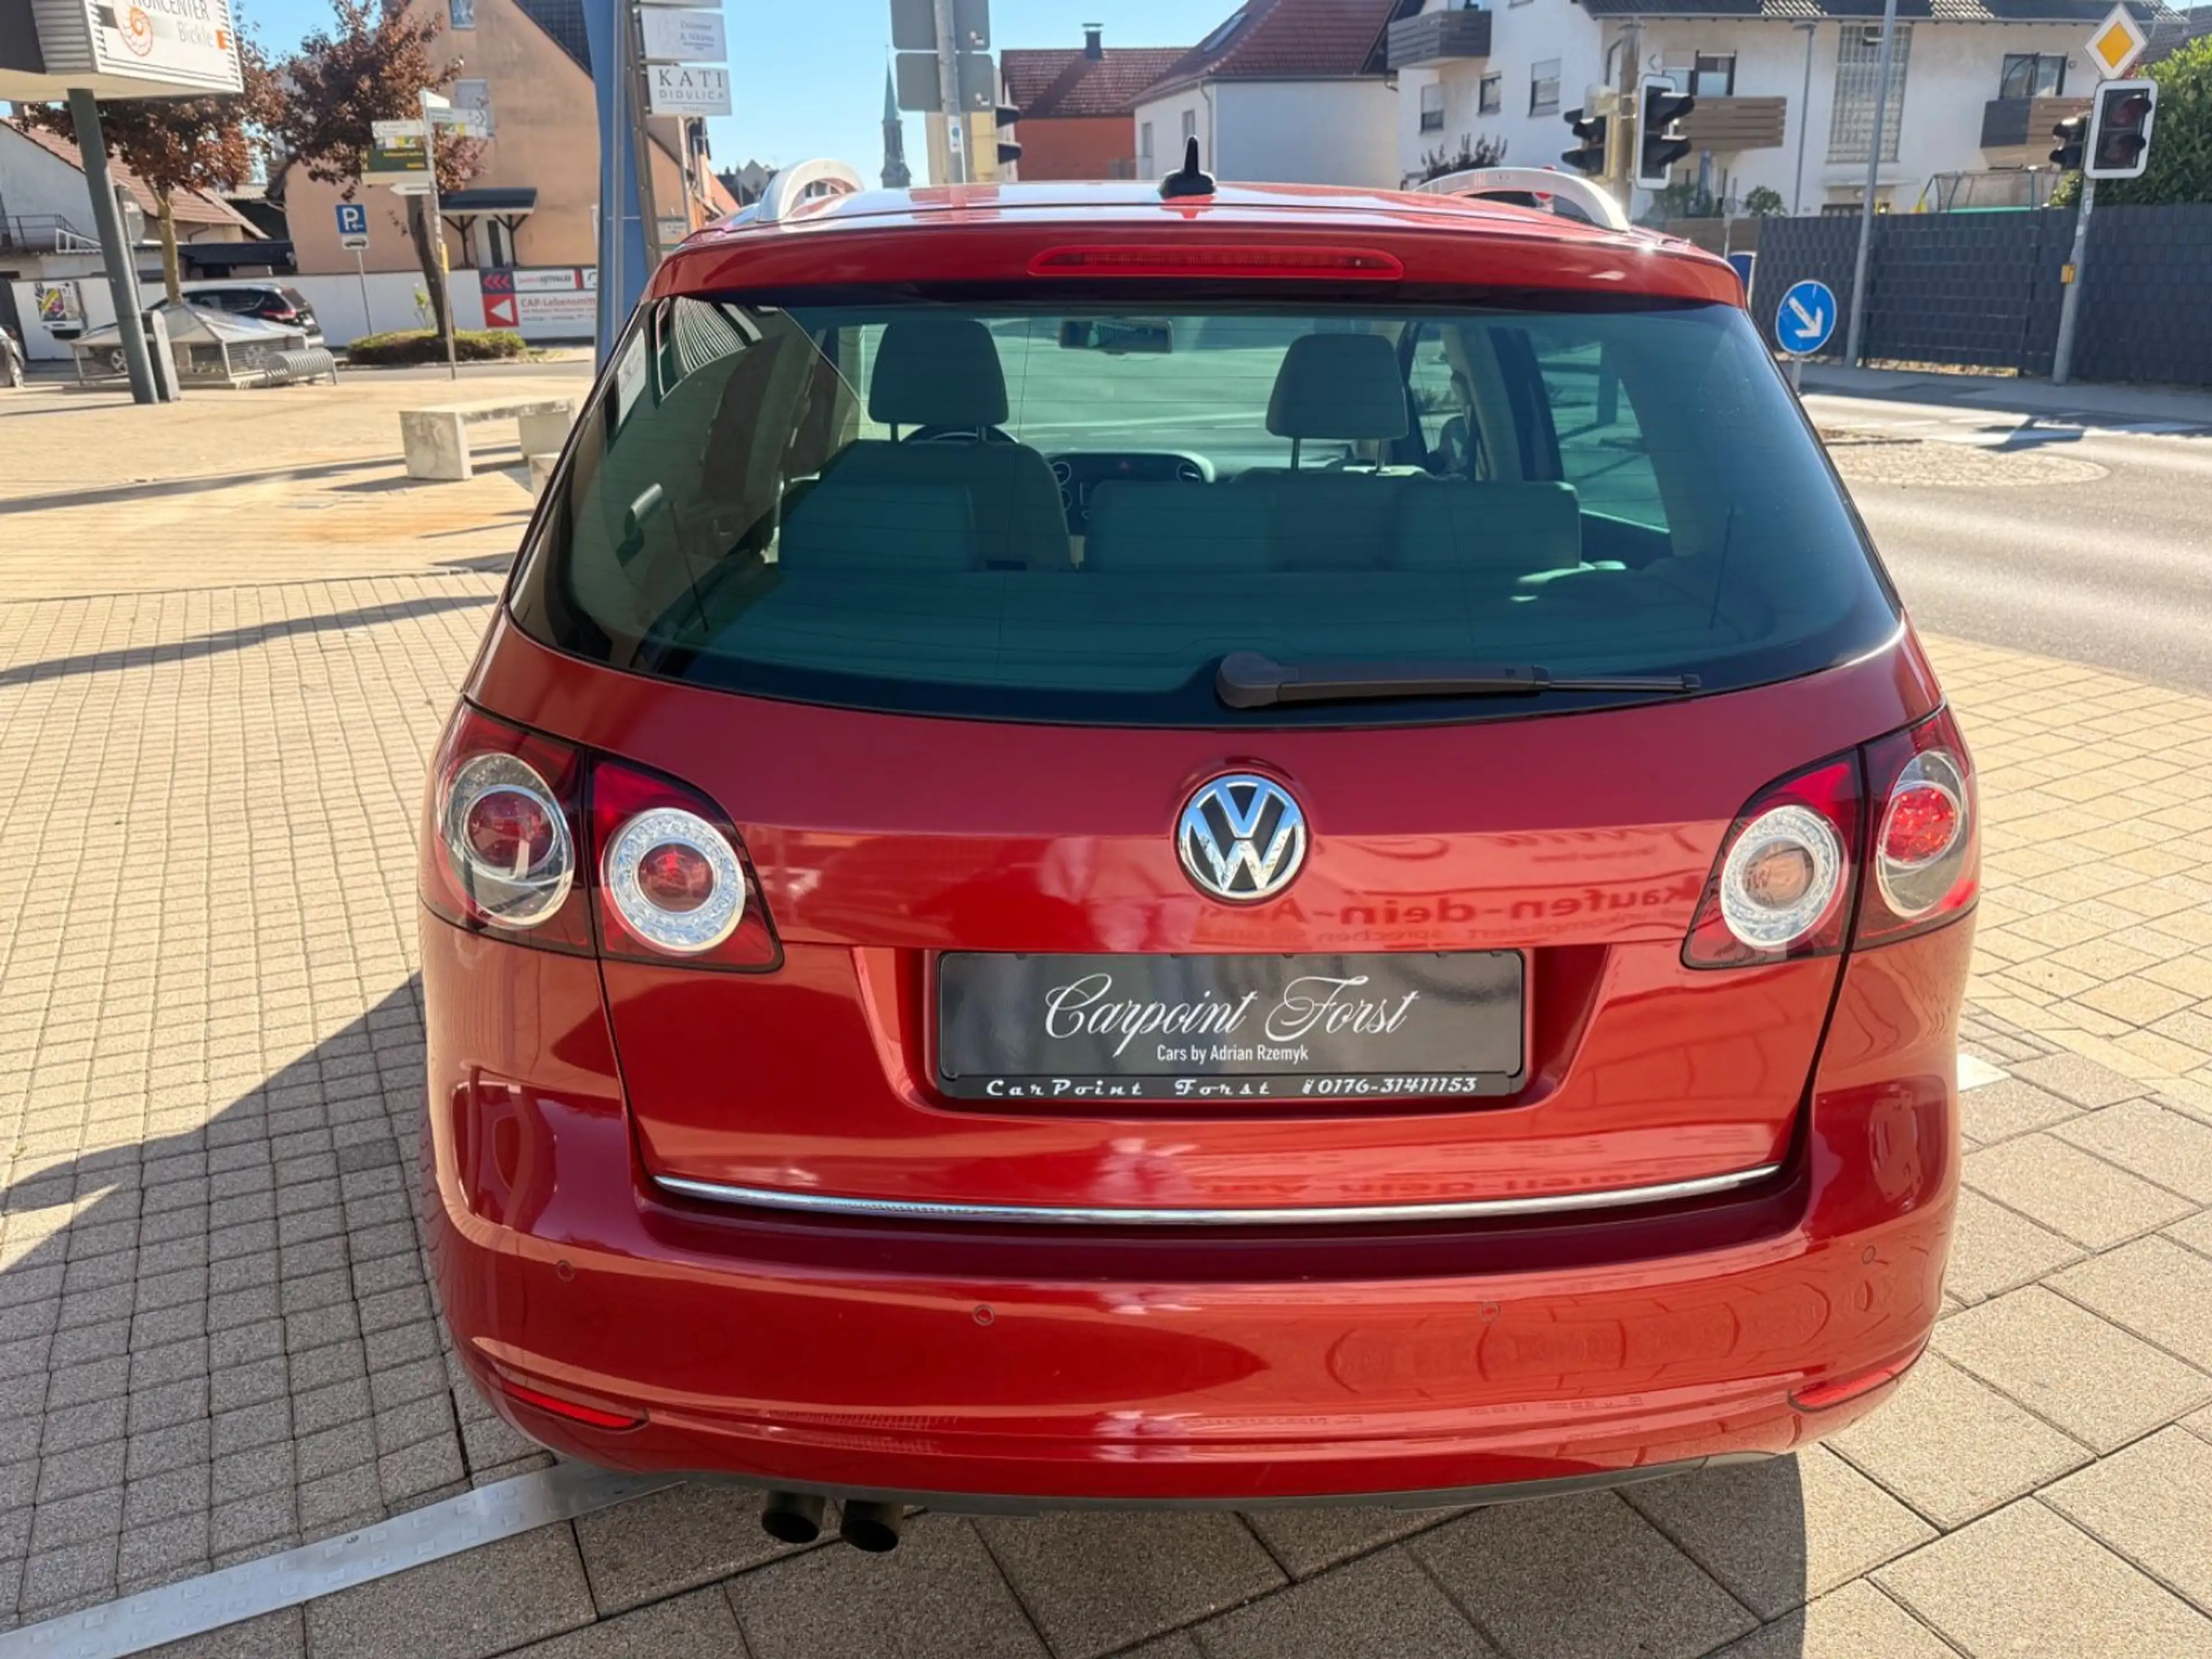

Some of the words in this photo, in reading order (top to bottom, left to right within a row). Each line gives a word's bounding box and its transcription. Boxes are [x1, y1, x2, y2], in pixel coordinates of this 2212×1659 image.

[132, 0, 210, 21] CENTER
[658, 69, 723, 88] KATI
[1045, 973, 1259, 1059] Carpoint
[1265, 975, 1420, 1041] Forst
[1157, 1044, 1187, 1061] Cars
[1190, 1044, 1206, 1065] by
[1210, 1044, 1253, 1061] Adrian
[1257, 1044, 1308, 1065] Rzemyk
[1317, 1077, 1477, 1094] 0176-31411153
